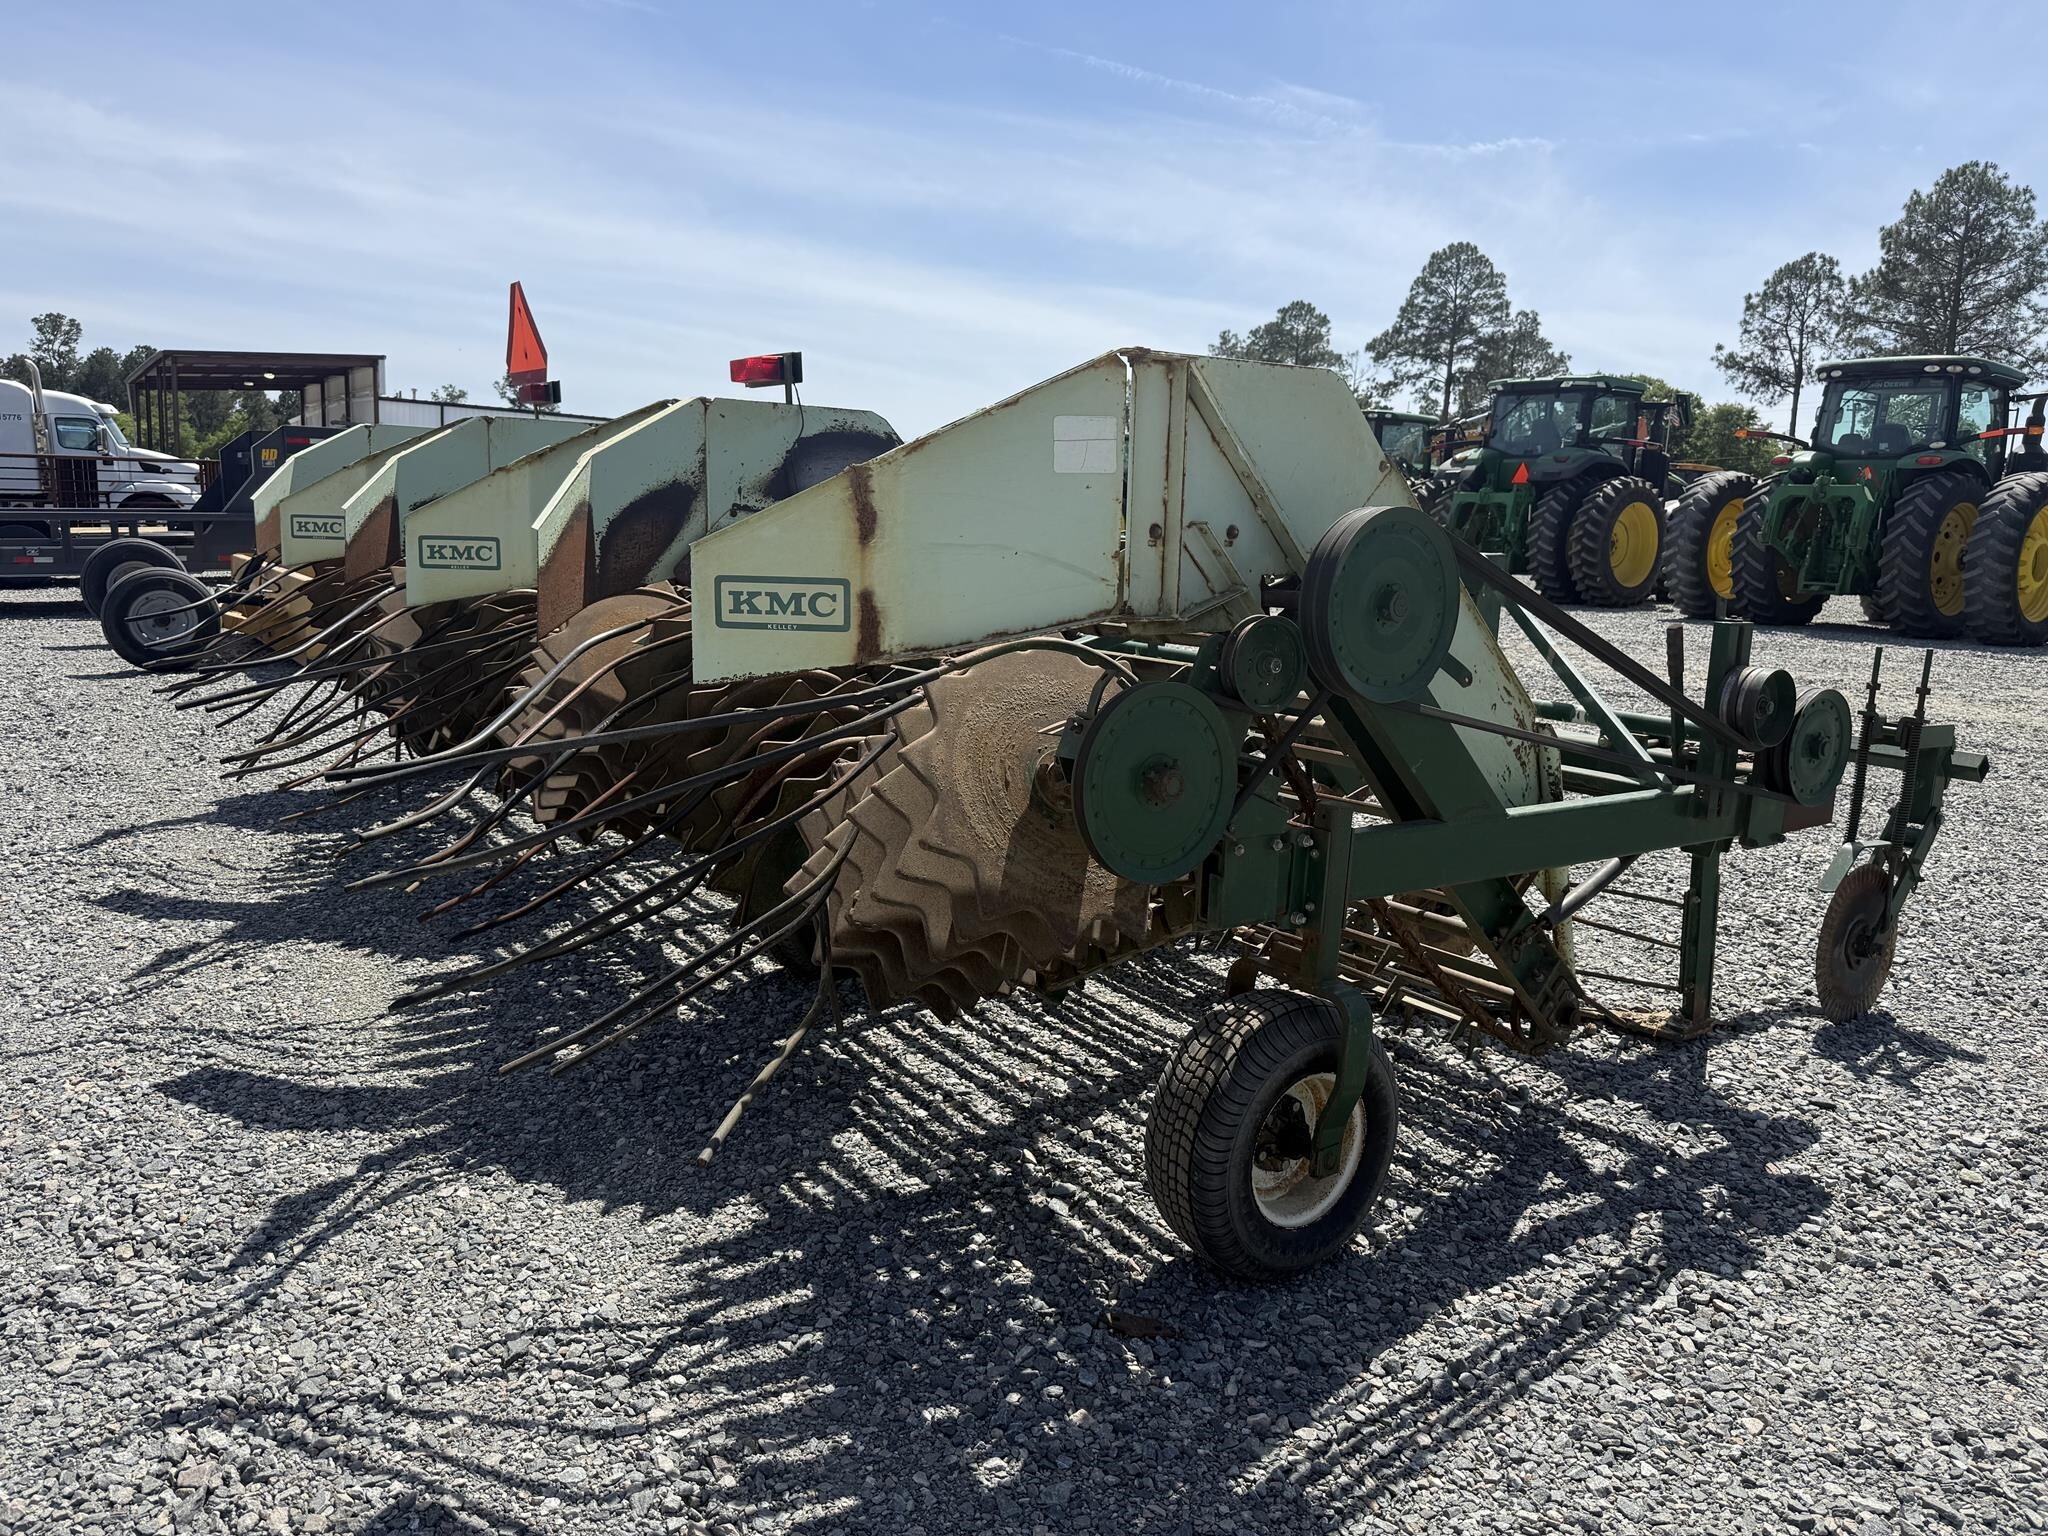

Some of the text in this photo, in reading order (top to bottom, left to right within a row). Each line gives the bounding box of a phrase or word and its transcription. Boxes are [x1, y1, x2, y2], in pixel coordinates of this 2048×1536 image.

[0, 413, 22, 421] 5776
[261, 448, 278, 460] HD
[296, 520, 342, 534] KMC
[426, 544, 493, 561] KMC
[727, 590, 837, 618] KMC
